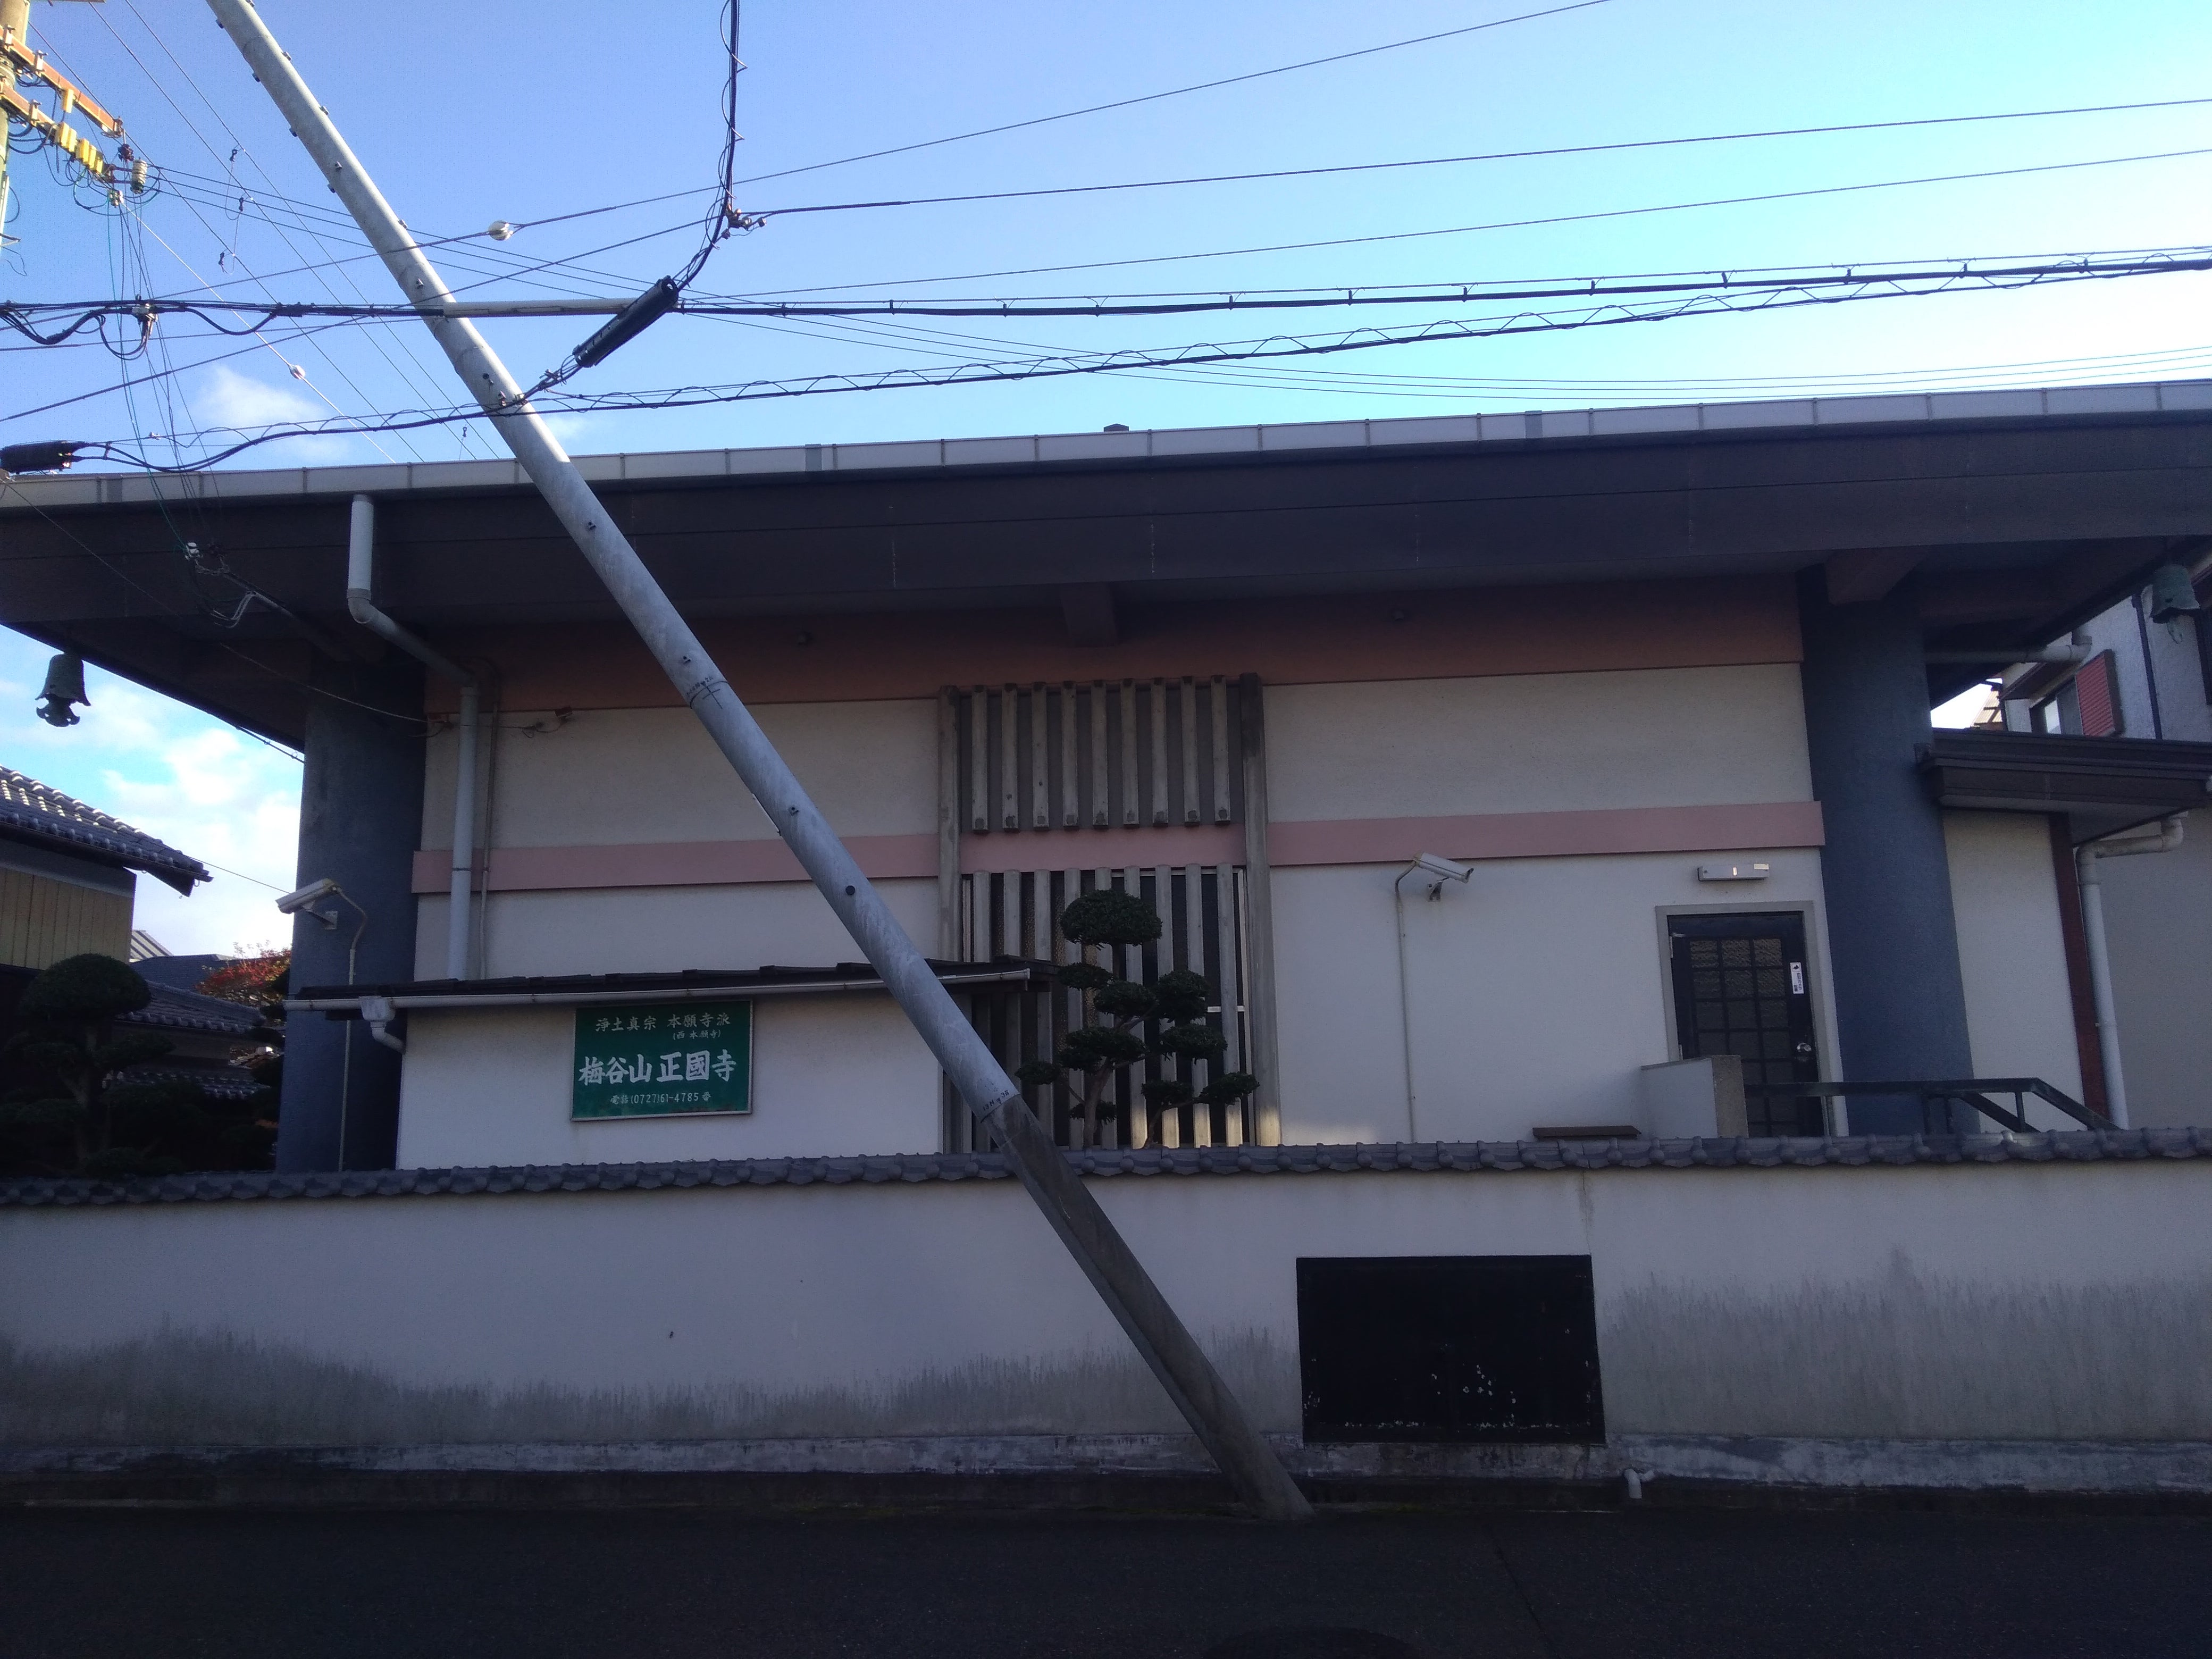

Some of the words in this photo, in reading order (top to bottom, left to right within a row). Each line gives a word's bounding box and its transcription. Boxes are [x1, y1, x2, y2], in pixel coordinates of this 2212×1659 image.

[595, 1015, 657, 1032] 浄土真宗
[667, 1012, 731, 1028] 本願寺派
